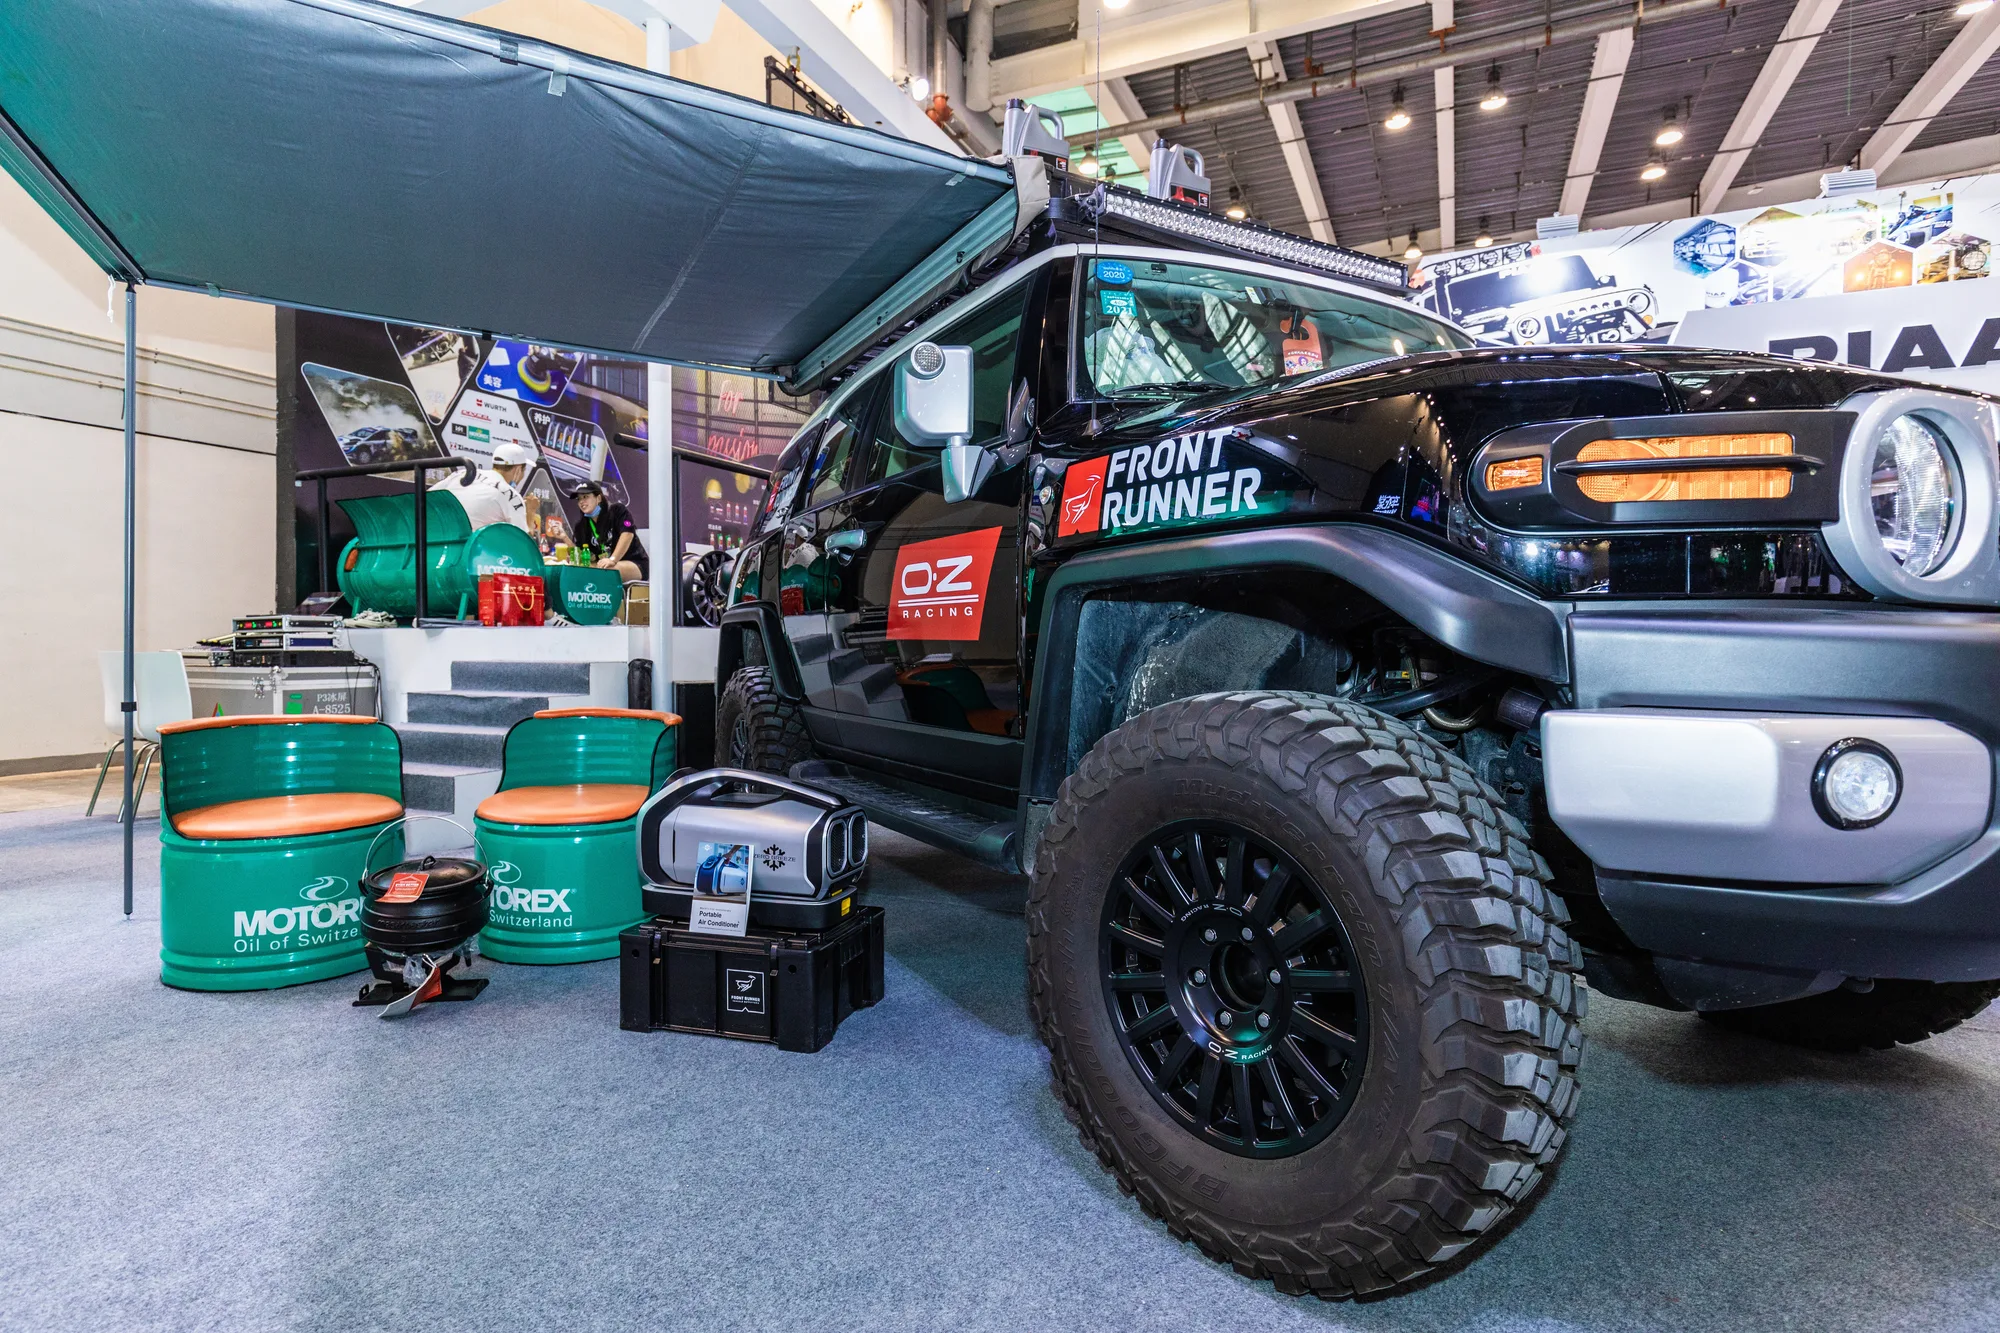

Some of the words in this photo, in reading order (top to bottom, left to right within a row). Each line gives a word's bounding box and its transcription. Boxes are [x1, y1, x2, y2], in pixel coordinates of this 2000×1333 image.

[1106, 305, 1132, 315] 2021
[484, 374, 501, 388] 美容
[499, 418, 519, 429] PIAA
[534, 412, 551, 424] 养护
[1107, 426, 1233, 488] FRONT
[1102, 467, 1262, 529] RUNNER
[477, 564, 531, 576] MOTOREX
[567, 591, 611, 603] MOTOREX
[902, 606, 973, 619] RACING
[317, 692, 347, 703] P3冰屏
[312, 703, 351, 714] A-8525
[234, 896, 366, 937] MOTOR
[489, 909, 573, 928] Switzerland
[699, 910, 722, 918] Portable
[234, 939, 260, 953] Oil
[270, 936, 290, 950] of
[298, 927, 362, 947] Switze
[1241, 1044, 1273, 1060] RACING
